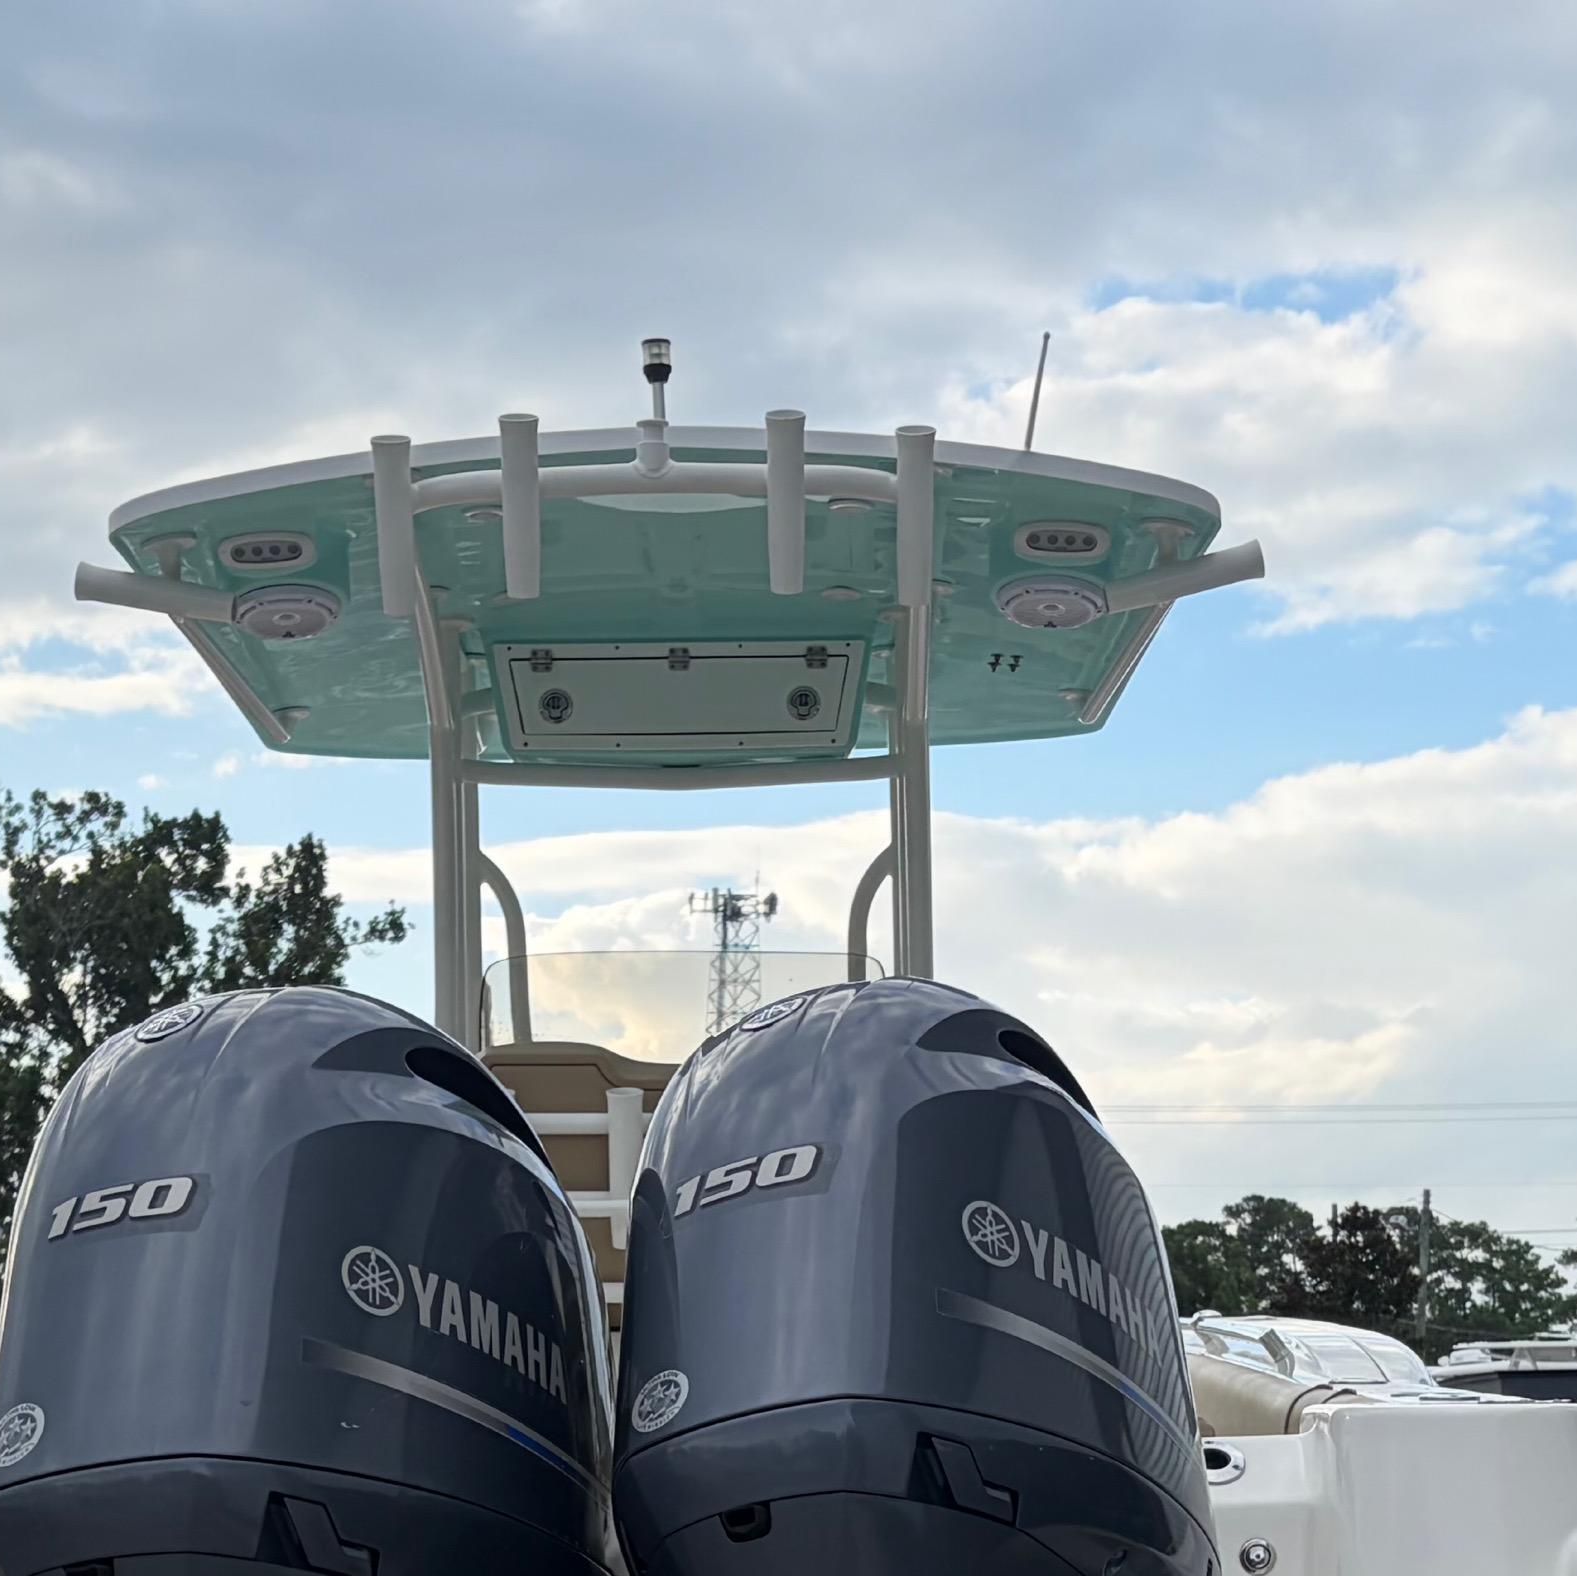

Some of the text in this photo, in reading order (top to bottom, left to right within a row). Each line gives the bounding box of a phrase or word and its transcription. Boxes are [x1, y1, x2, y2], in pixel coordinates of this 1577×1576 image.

[47, 1176, 193, 1240] 150
[674, 1144, 818, 1217] 150
[407, 1263, 568, 1405] YAMAHA
[1020, 1219, 1164, 1369] YAMAHA
